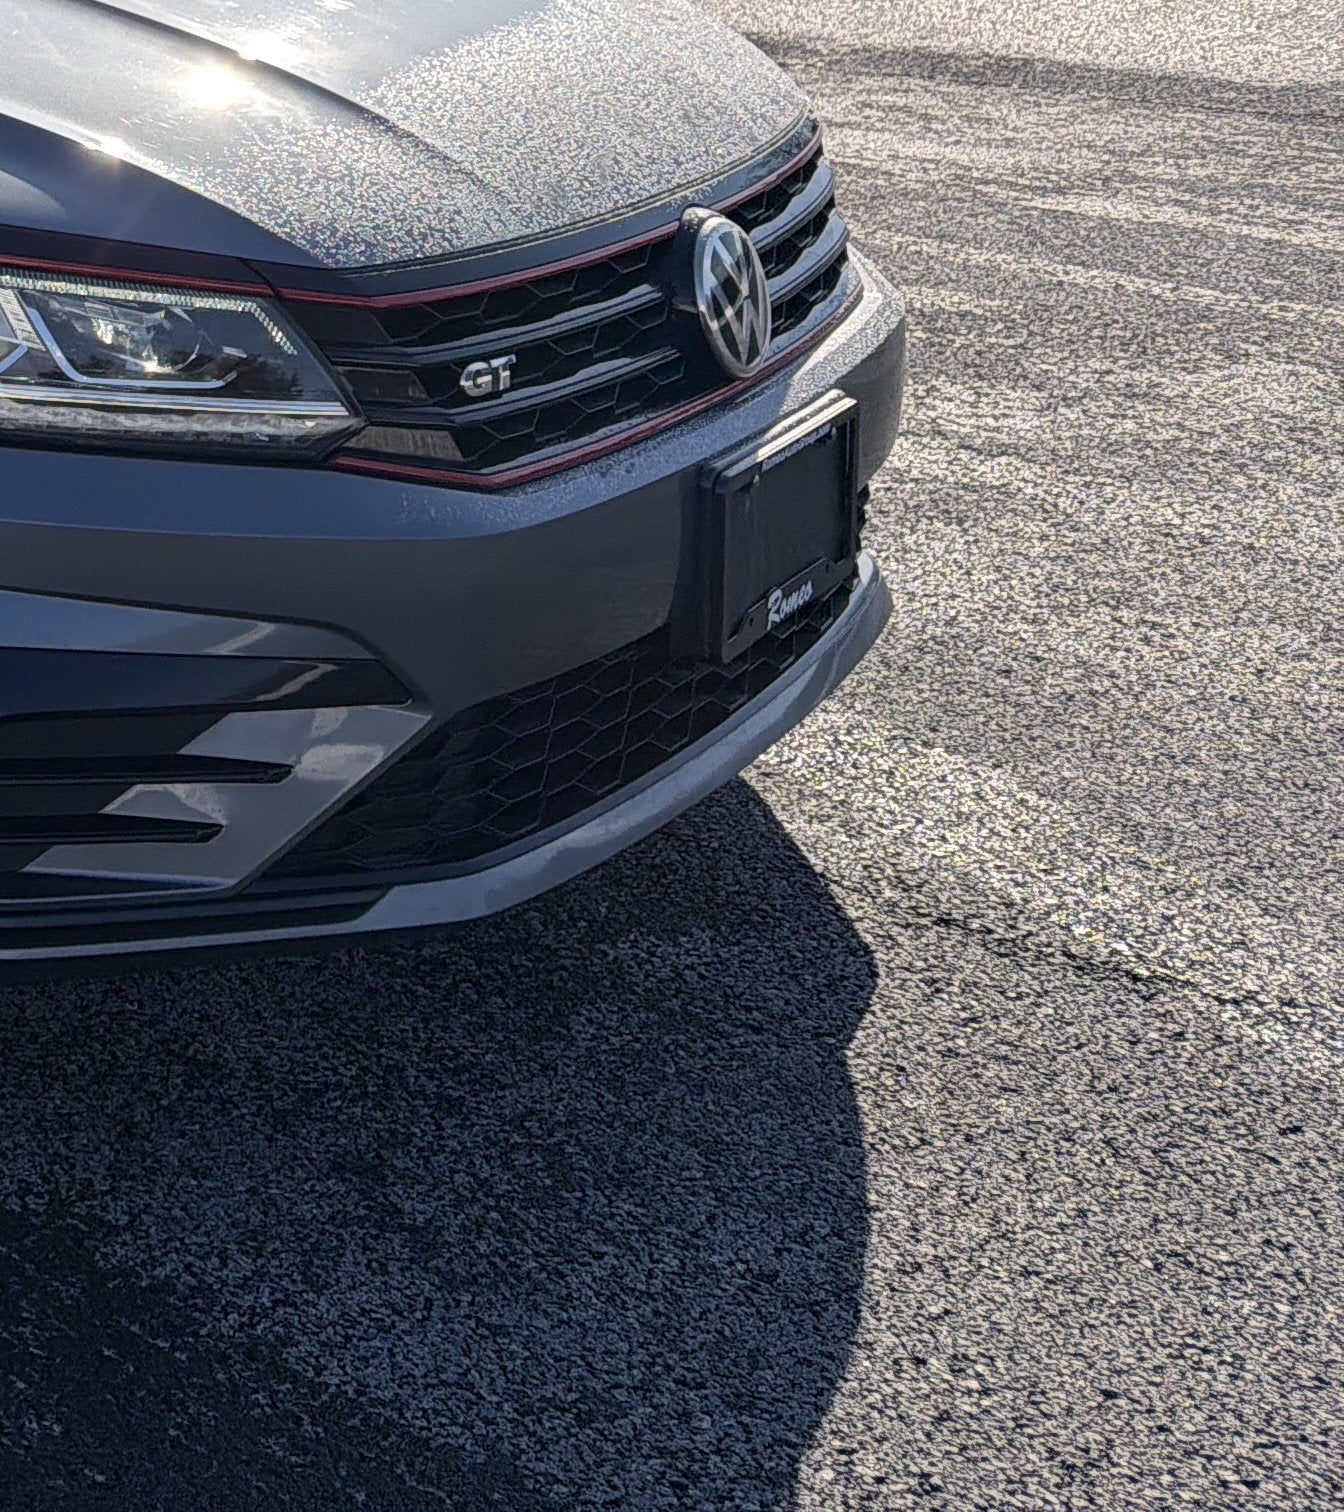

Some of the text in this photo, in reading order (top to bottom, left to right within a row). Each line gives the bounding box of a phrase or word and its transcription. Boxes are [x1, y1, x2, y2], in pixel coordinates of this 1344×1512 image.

[698, 220, 769, 373] VW
[460, 354, 516, 397] GT
[767, 580, 813, 630] Romeo
